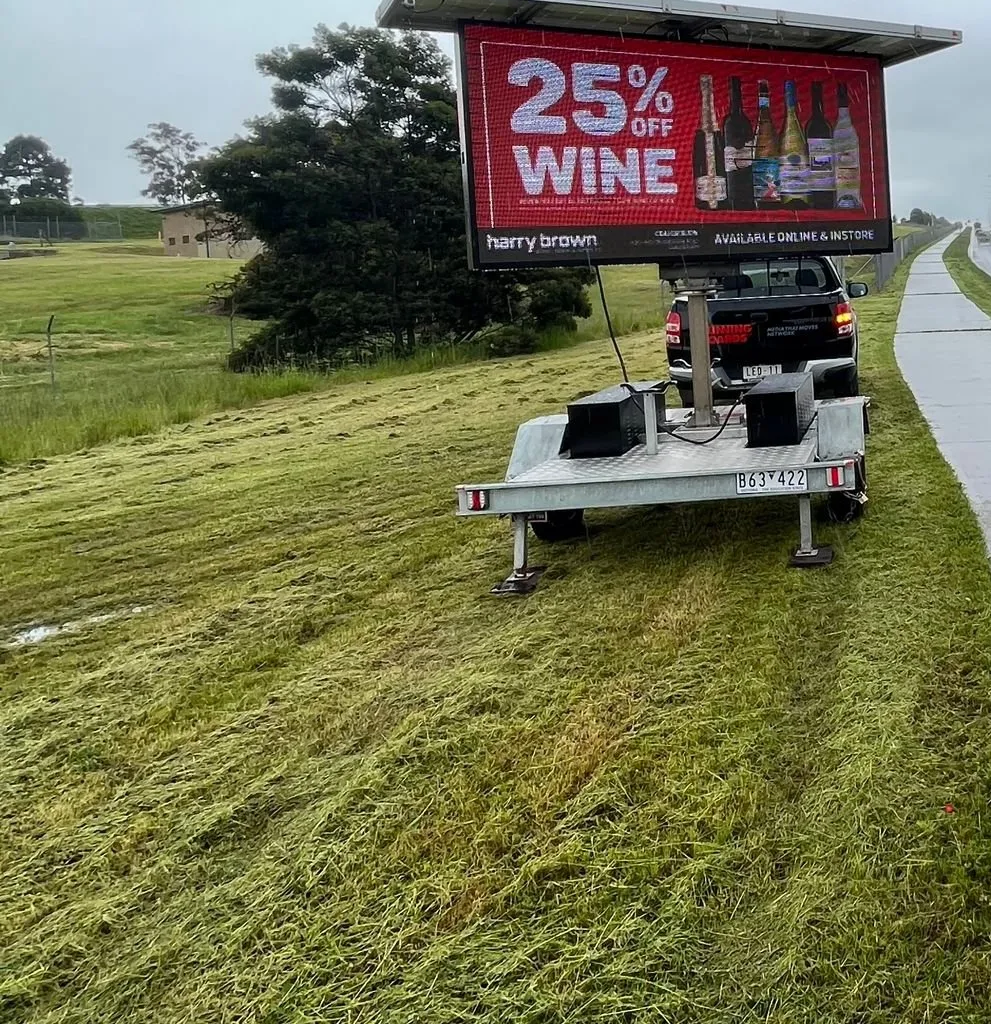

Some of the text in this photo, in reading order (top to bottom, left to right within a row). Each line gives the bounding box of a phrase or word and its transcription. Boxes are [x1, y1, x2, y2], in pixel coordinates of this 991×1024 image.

[507, 57, 674, 136] 25%
[631, 117, 673, 137] OFF
[512, 145, 678, 195] WINE
[486, 232, 597, 252] harry brown
[714, 232, 776, 245] AVAILABLE
[777, 231, 817, 243] ONLINE
[819, 231, 828, 241] &
[830, 229, 874, 241] INSTORE
